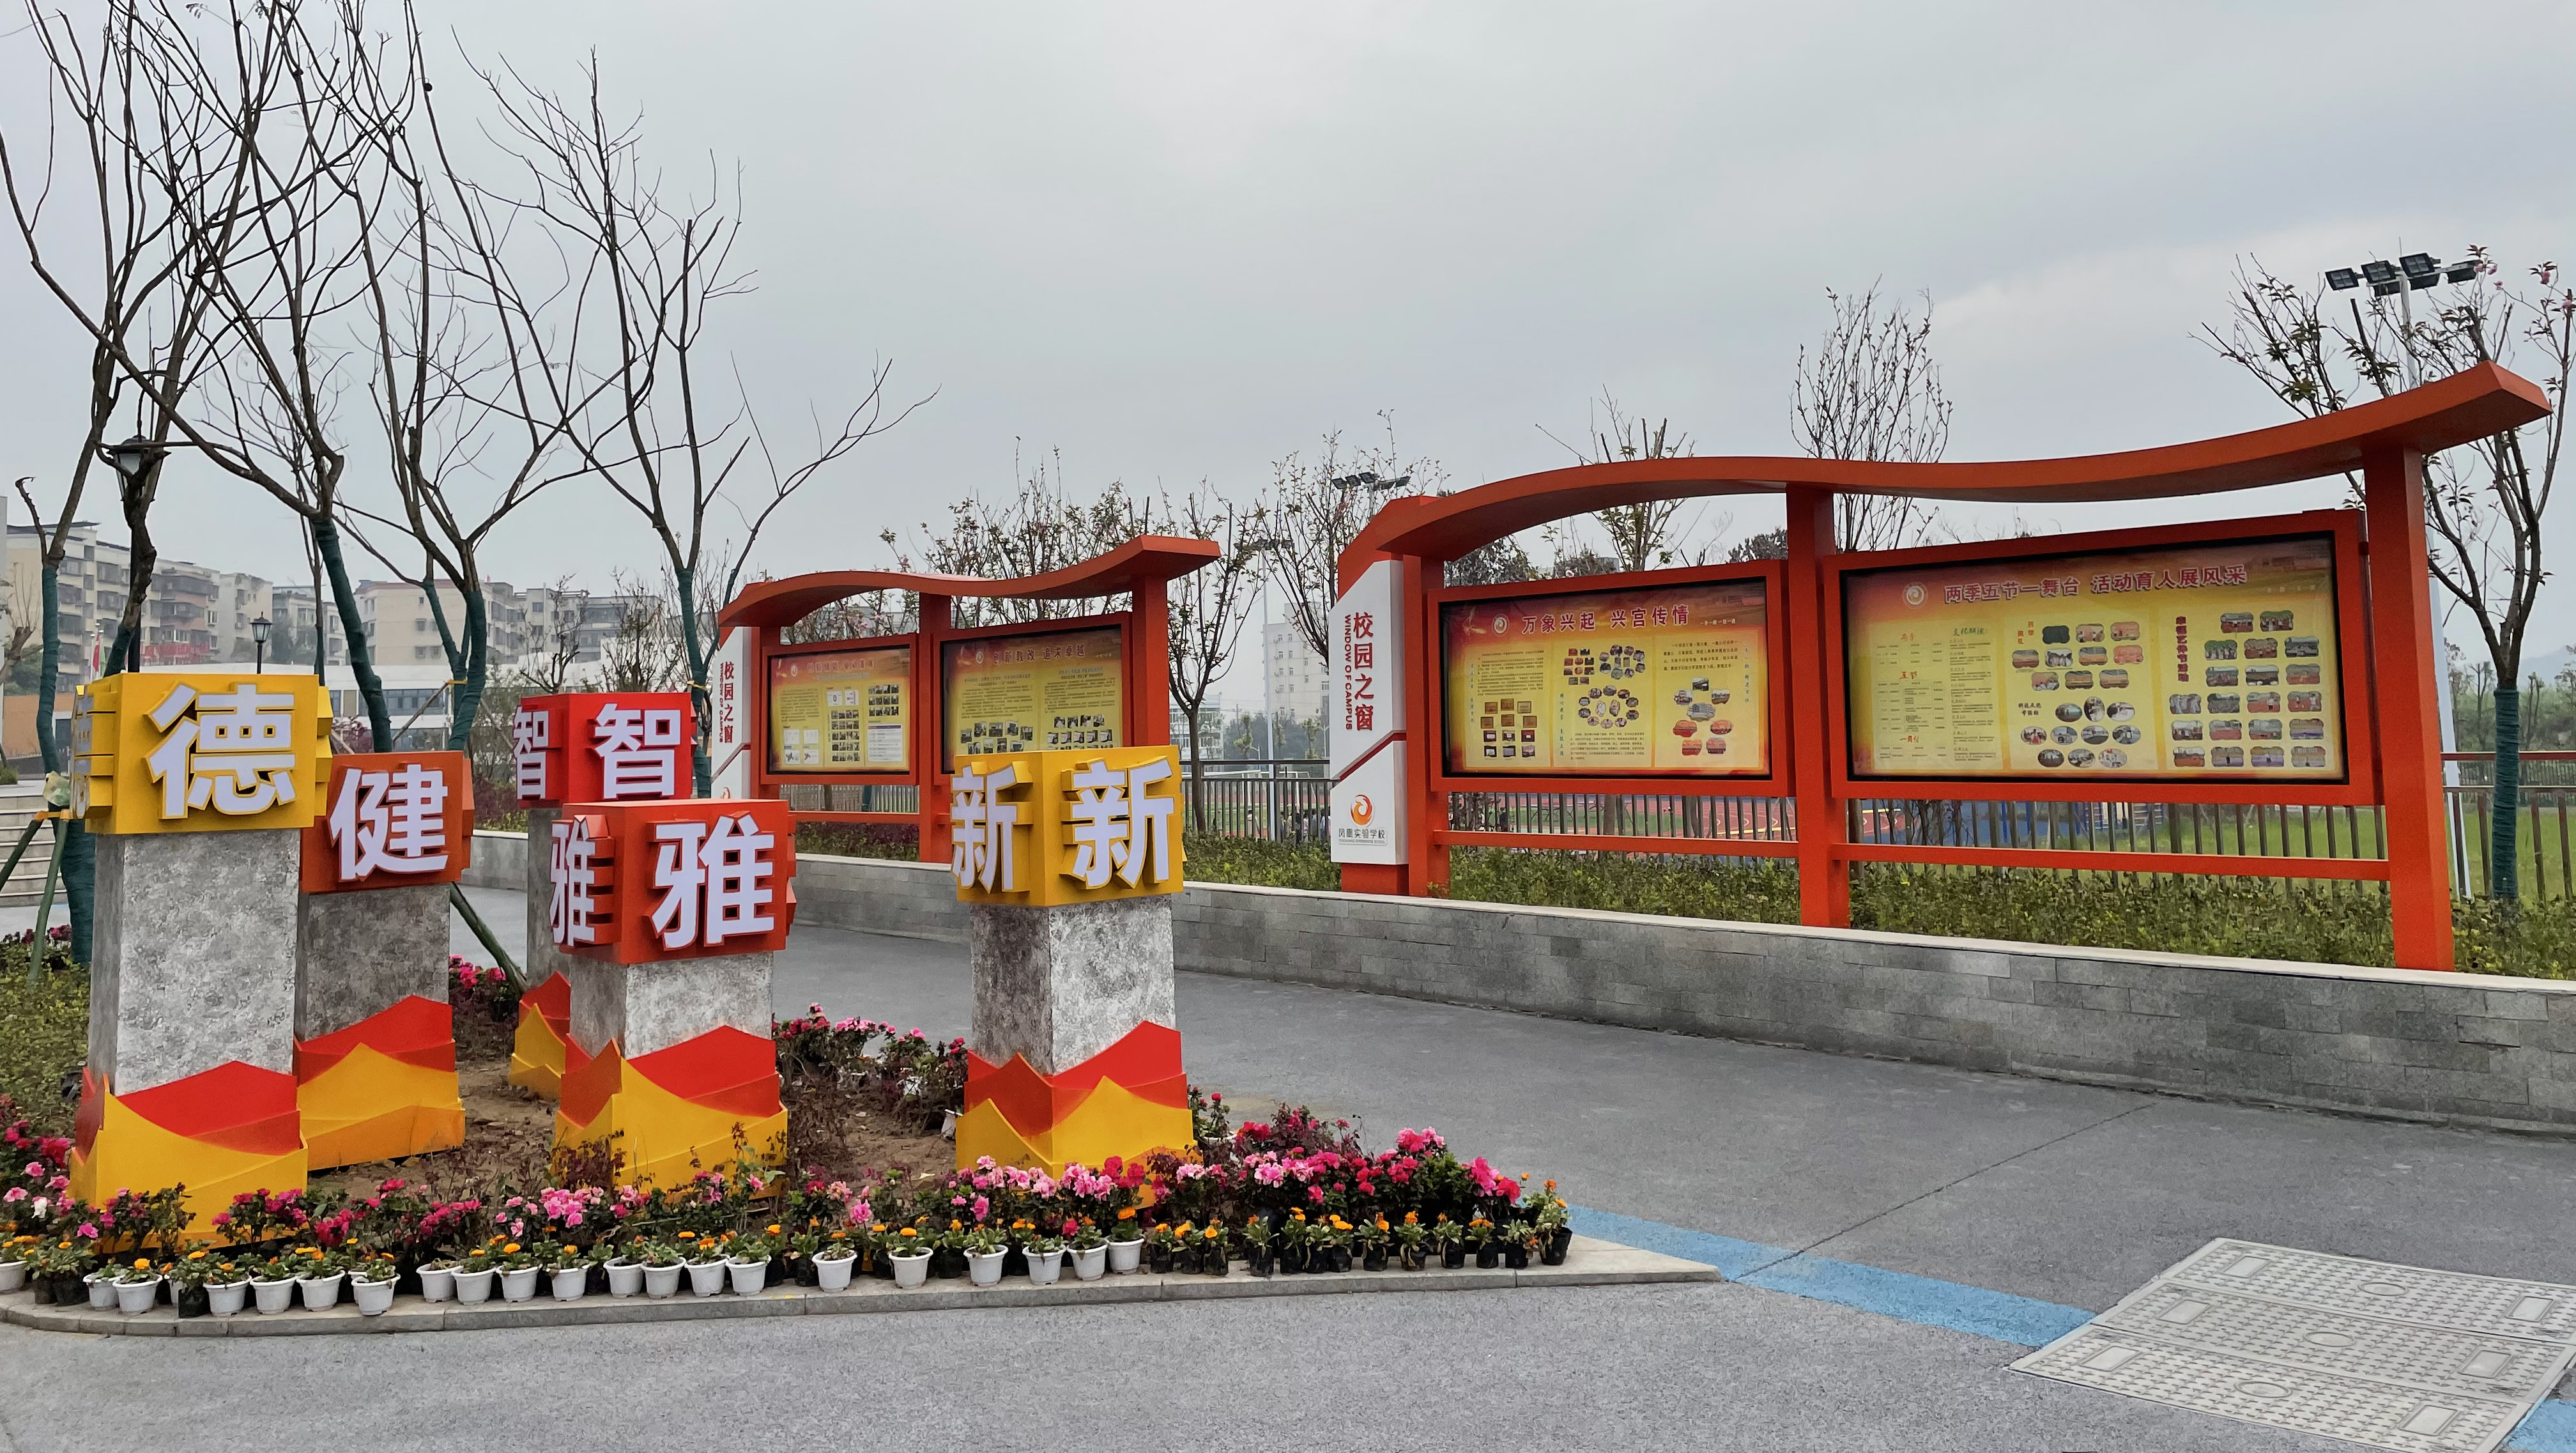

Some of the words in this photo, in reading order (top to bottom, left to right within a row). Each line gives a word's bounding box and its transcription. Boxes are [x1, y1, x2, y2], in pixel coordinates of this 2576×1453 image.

[1522, 611, 1596, 634] 万象兴起
[1944, 578, 2080, 604] 两季五节一舞台
[2090, 564, 2248, 594] 活动育人展风采
[724, 661, 734, 743] 校园之窗
[993, 649, 1035, 665] 创新教改
[1042, 643, 1085, 661] 追求卓越
[1345, 665, 1352, 680] OF
[1353, 611, 1374, 731] 校园之窗
[148, 682, 296, 818] 德
[513, 705, 548, 799] 智
[595, 703, 681, 799] 智
[329, 764, 448, 880] 健
[952, 765, 1017, 893] 新
[1072, 759, 1174, 889] 新
[1338, 828, 1385, 839] 凤凰实验学校
[549, 820, 596, 947] 雅
[651, 814, 775, 949] 雅
